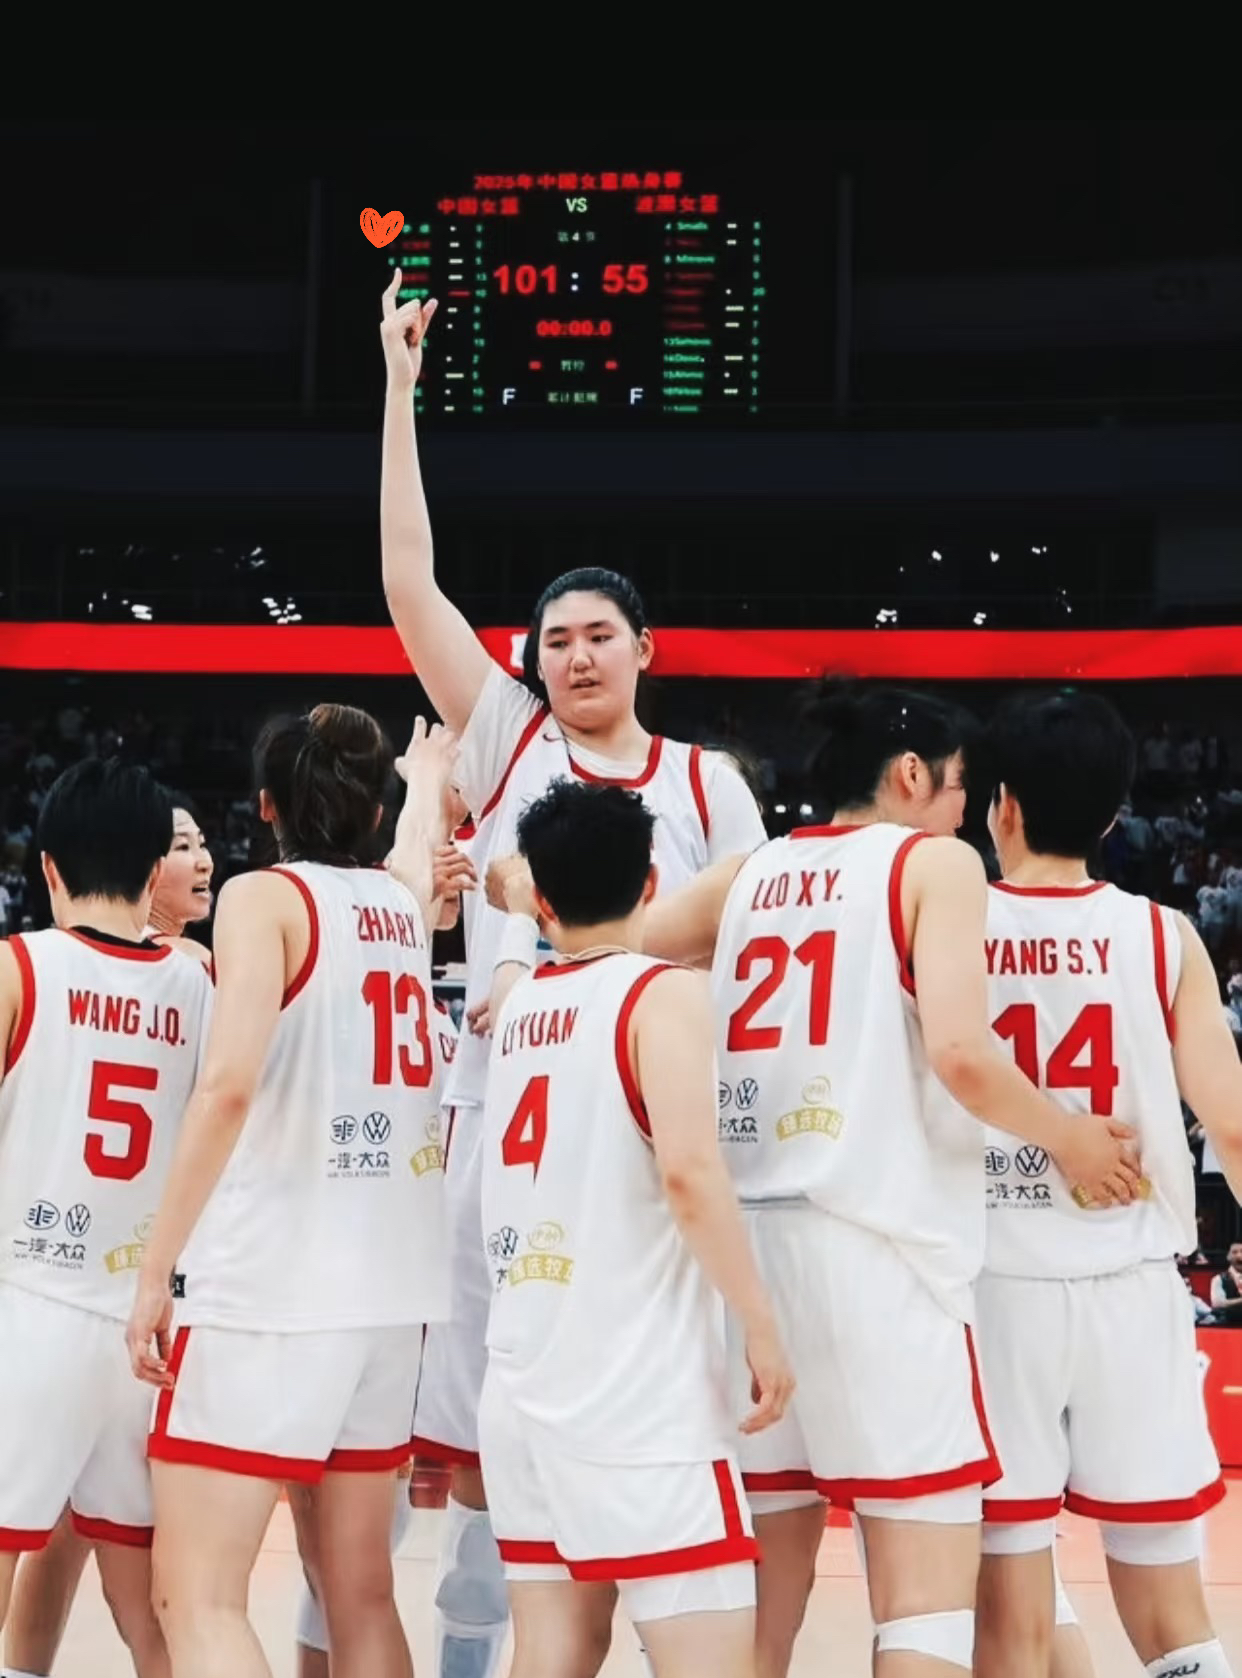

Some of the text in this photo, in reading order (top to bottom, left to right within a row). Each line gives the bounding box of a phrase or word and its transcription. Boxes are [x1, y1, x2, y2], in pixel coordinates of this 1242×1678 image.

[566, 197, 588, 213] VS
[494, 264, 558, 295] 101
[602, 264, 649, 295] 55
[536, 319, 613, 337] 00:00.0
[502, 387, 517, 406] F
[630, 387, 644, 405] F
[984, 938, 1058, 975] YANG
[727, 930, 837, 1052] 21
[68, 988, 187, 1046] WANG J.Q.
[361, 970, 433, 1088] 13
[991, 1003, 1119, 1117] 14
[84, 1060, 159, 1181] 5
[501, 1075, 550, 1180] 4
